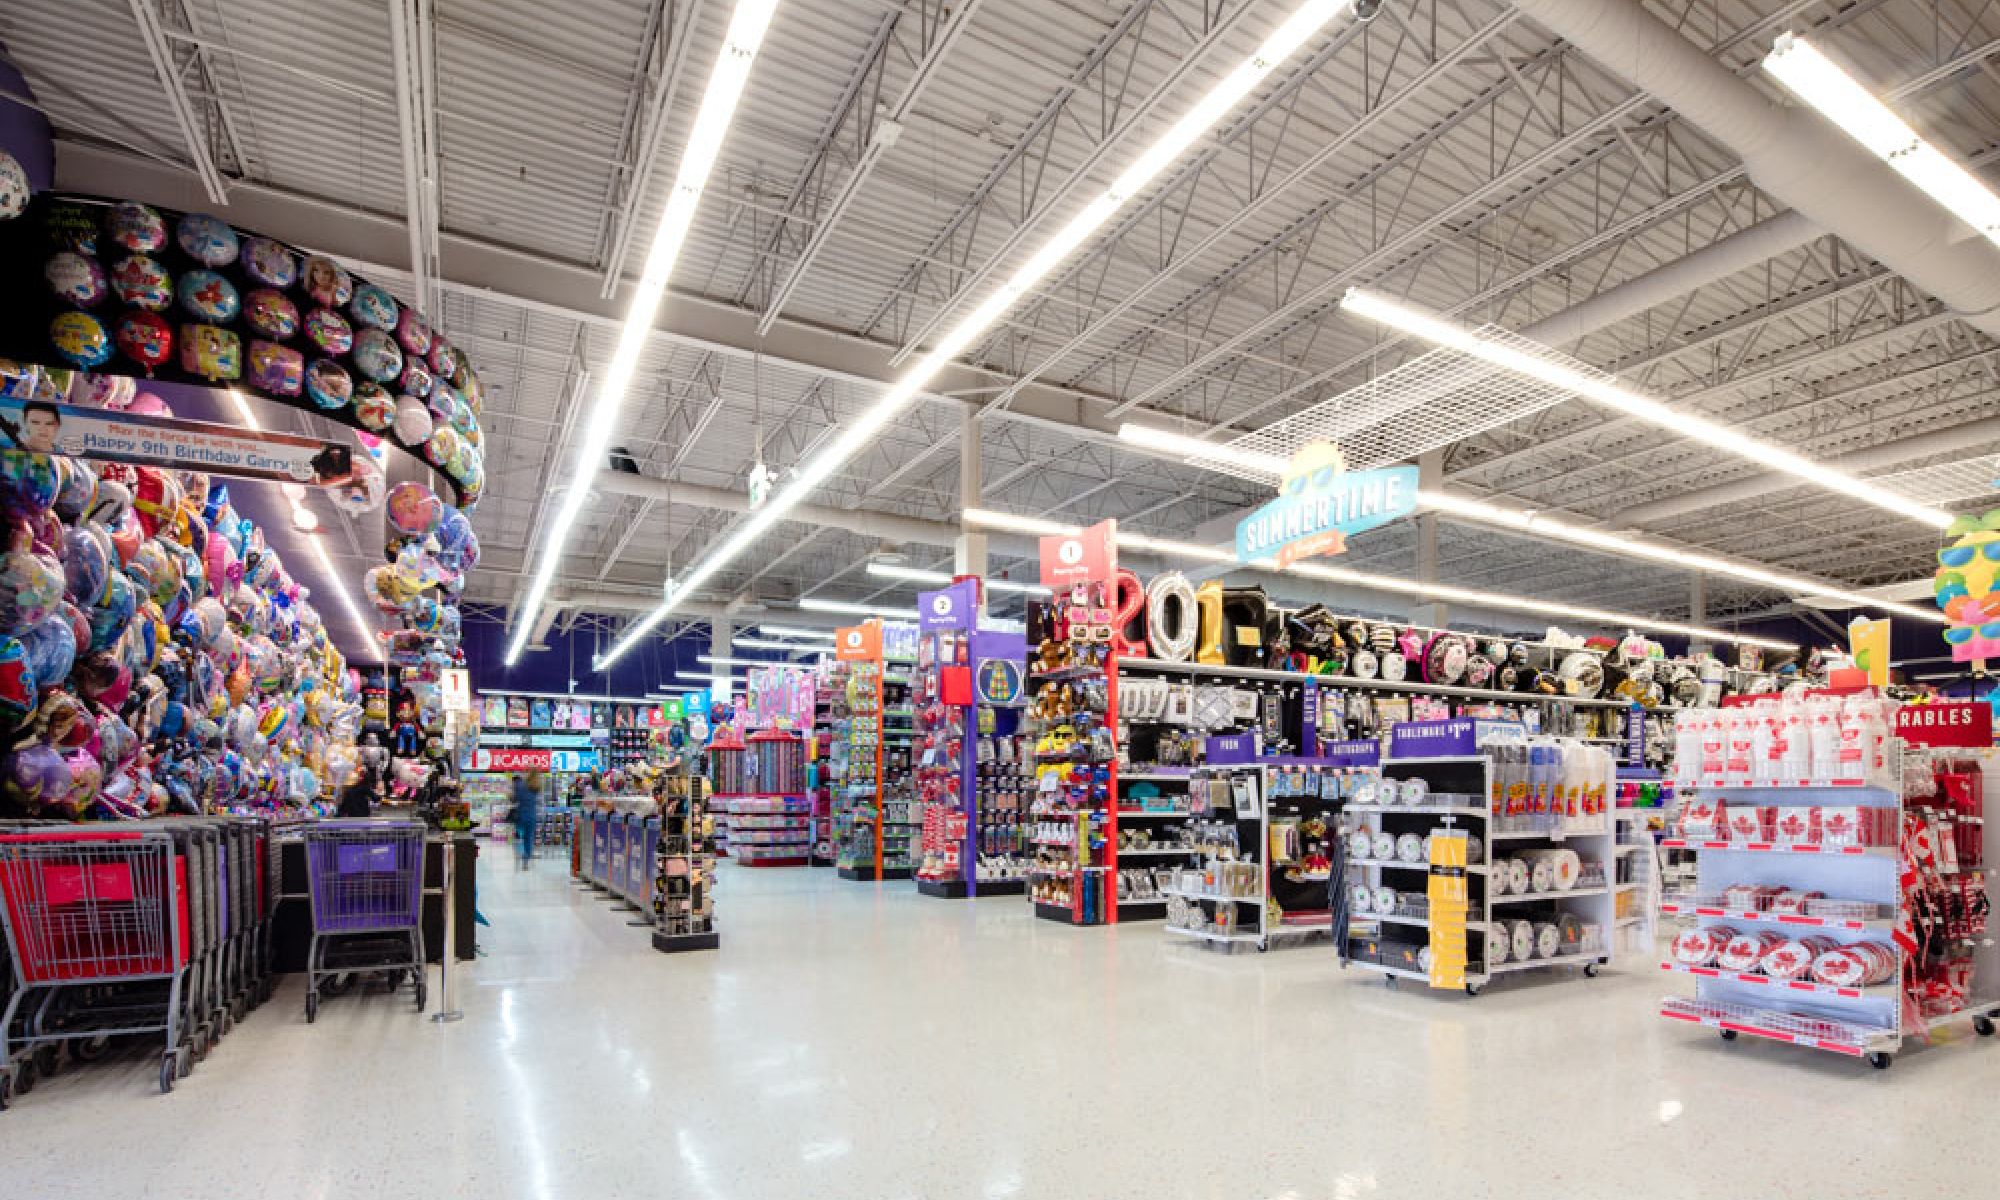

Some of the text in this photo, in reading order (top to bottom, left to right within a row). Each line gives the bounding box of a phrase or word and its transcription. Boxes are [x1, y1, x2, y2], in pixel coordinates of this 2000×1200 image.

[83, 432, 135, 451] Happy
[141, 440, 168, 456] 9th
[175, 444, 240, 464] Birthday
[1246, 475, 1401, 552] SUMMERTIME
